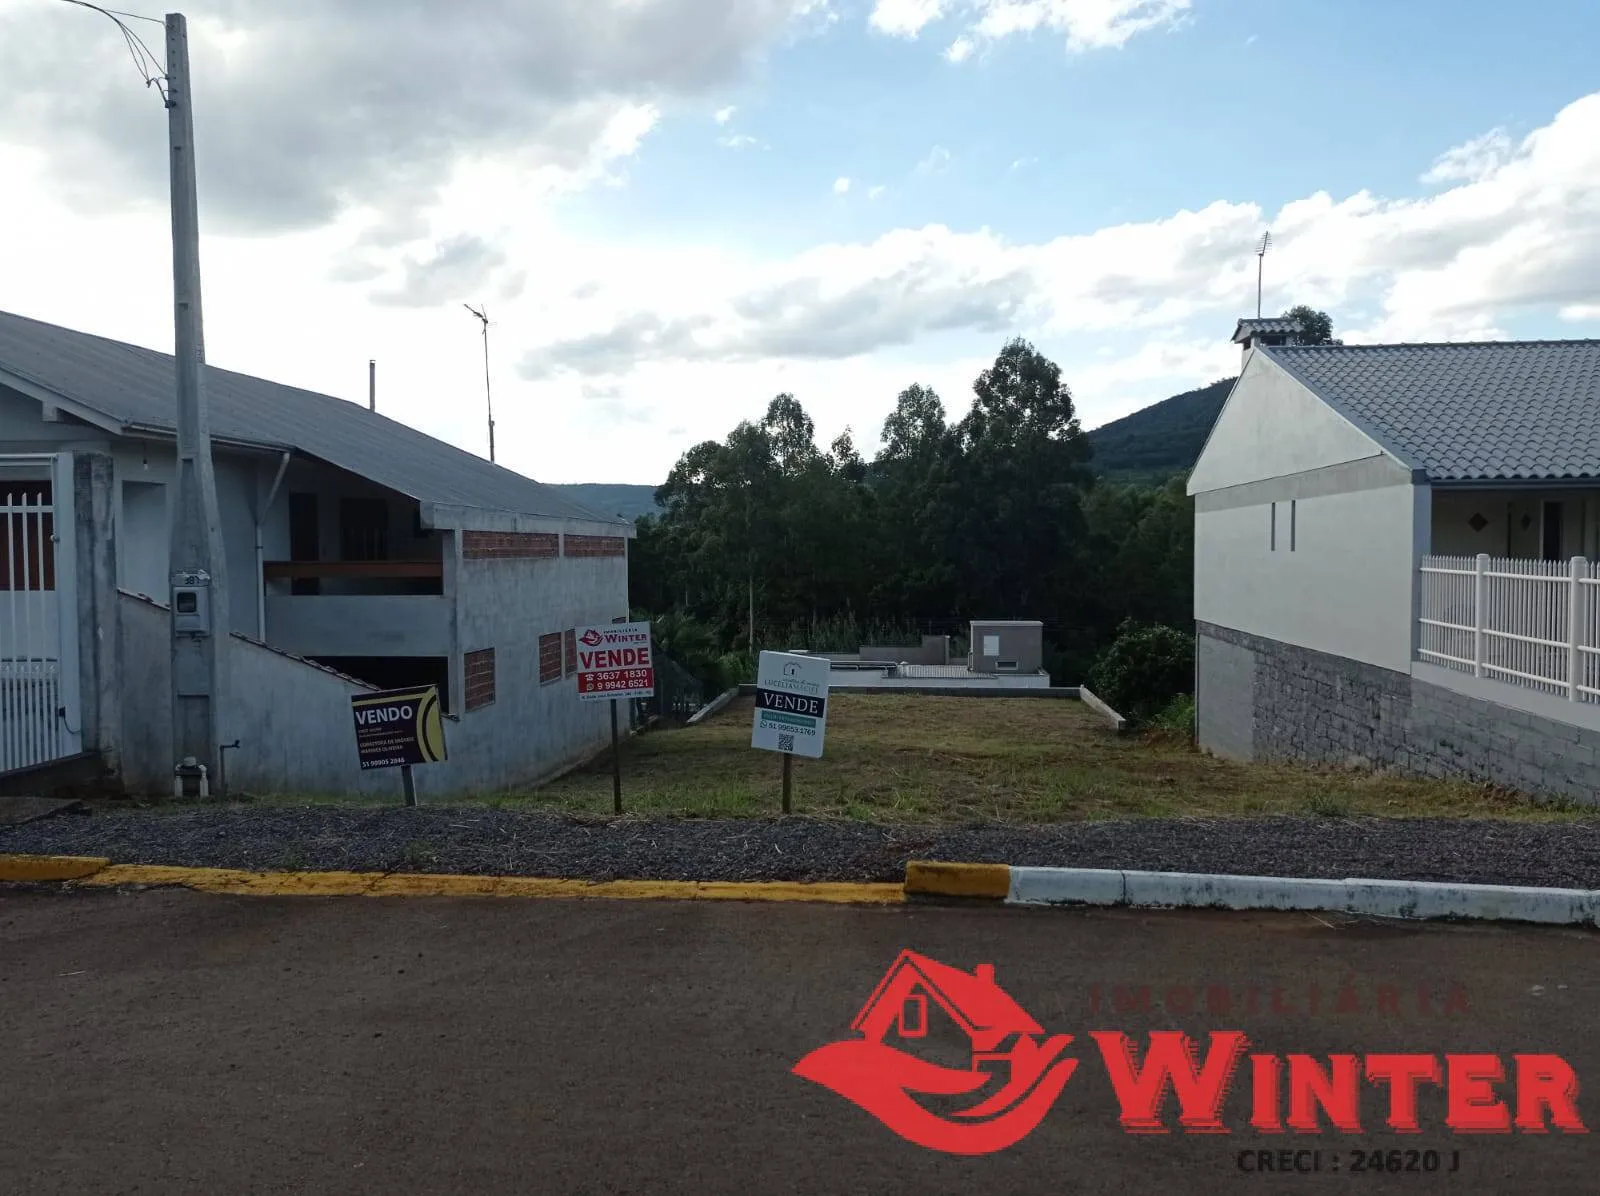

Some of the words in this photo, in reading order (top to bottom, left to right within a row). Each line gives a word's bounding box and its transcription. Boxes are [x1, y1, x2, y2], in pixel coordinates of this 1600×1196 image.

[604, 633, 647, 643] WINTER
[579, 647, 650, 669] VENDE
[596, 671, 620, 680] 3637
[624, 669, 647, 679] 1830
[597, 682, 603, 690] 9
[605, 680, 626, 690] 9942
[628, 679, 648, 688] 6521
[763, 692, 819, 714] VENDE
[355, 705, 413, 725] VENDO
